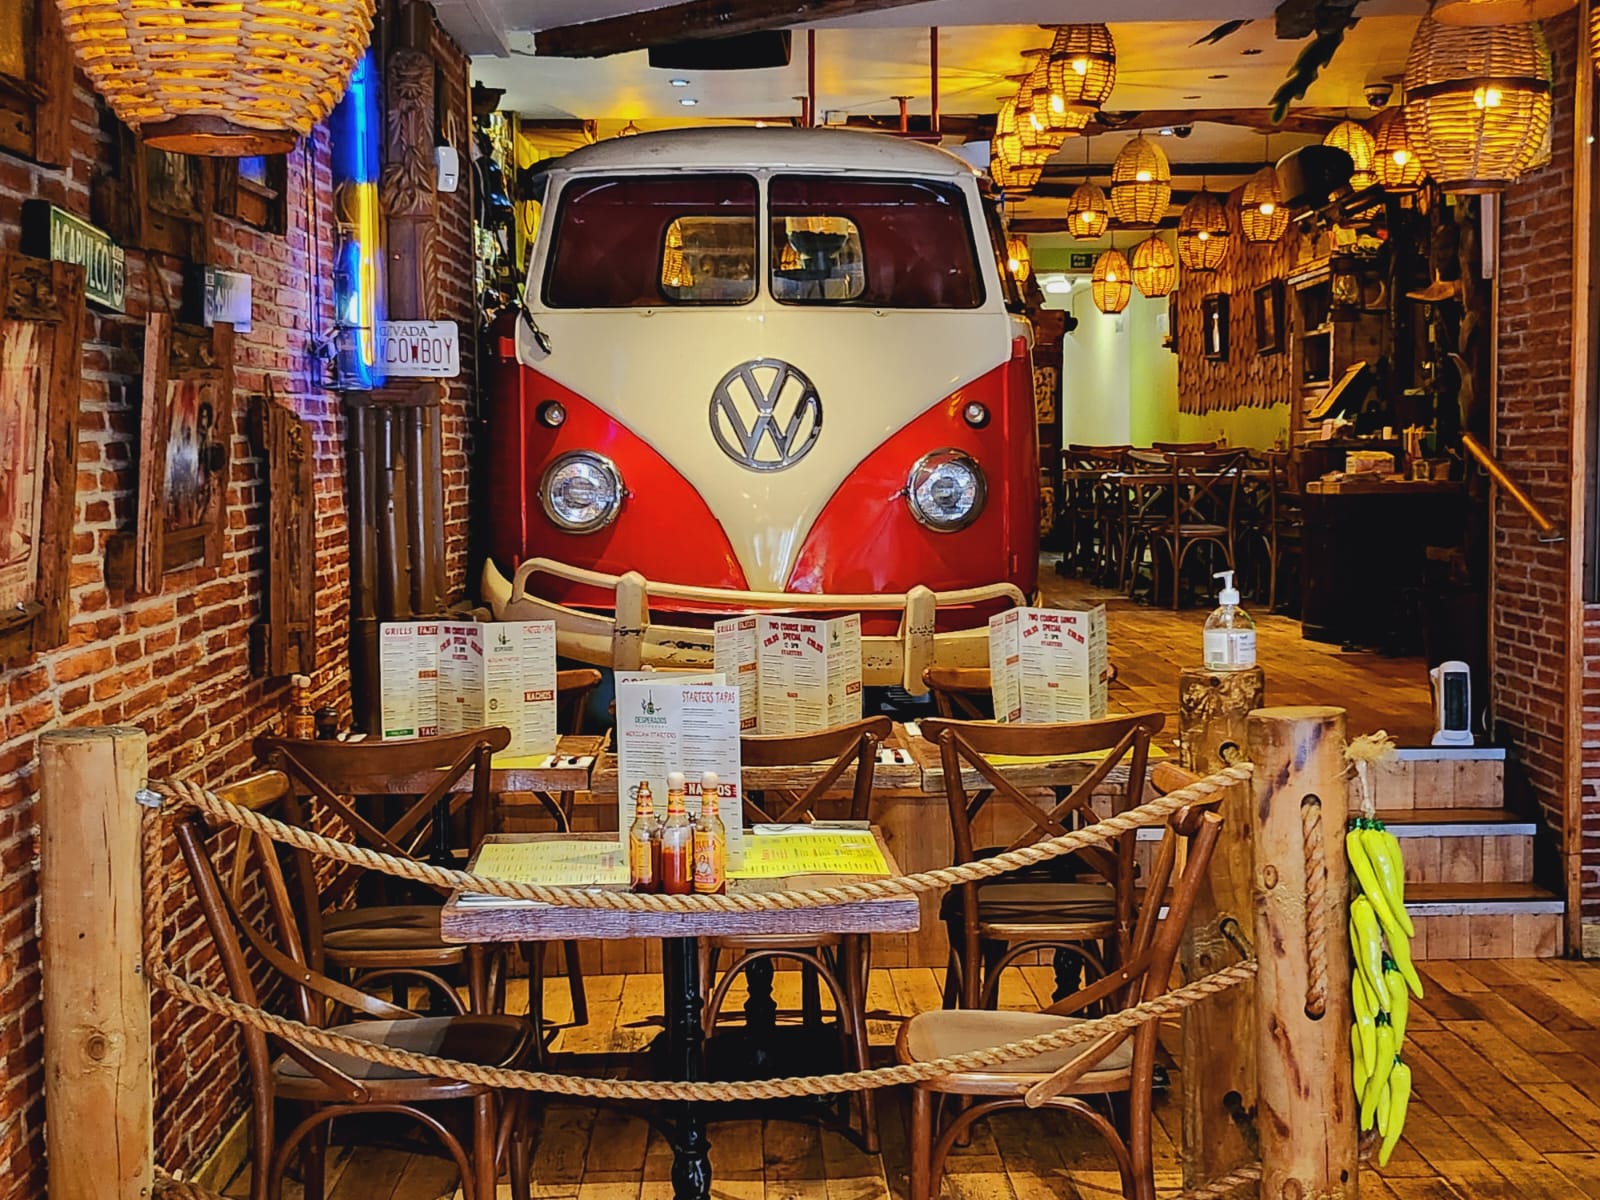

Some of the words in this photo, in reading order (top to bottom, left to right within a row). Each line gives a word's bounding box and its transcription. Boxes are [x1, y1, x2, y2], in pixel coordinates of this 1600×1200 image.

[54, 219, 109, 293] ACAPULCO
[709, 358, 822, 472] VW
[385, 627, 413, 636] GRILLS
[682, 690, 713, 703] STARTERS
[716, 691, 736, 704] TAPAS
[635, 716, 668, 725] DESPERADOS
[421, 728, 438, 736] TAC
[688, 784, 732, 797] NAOS
